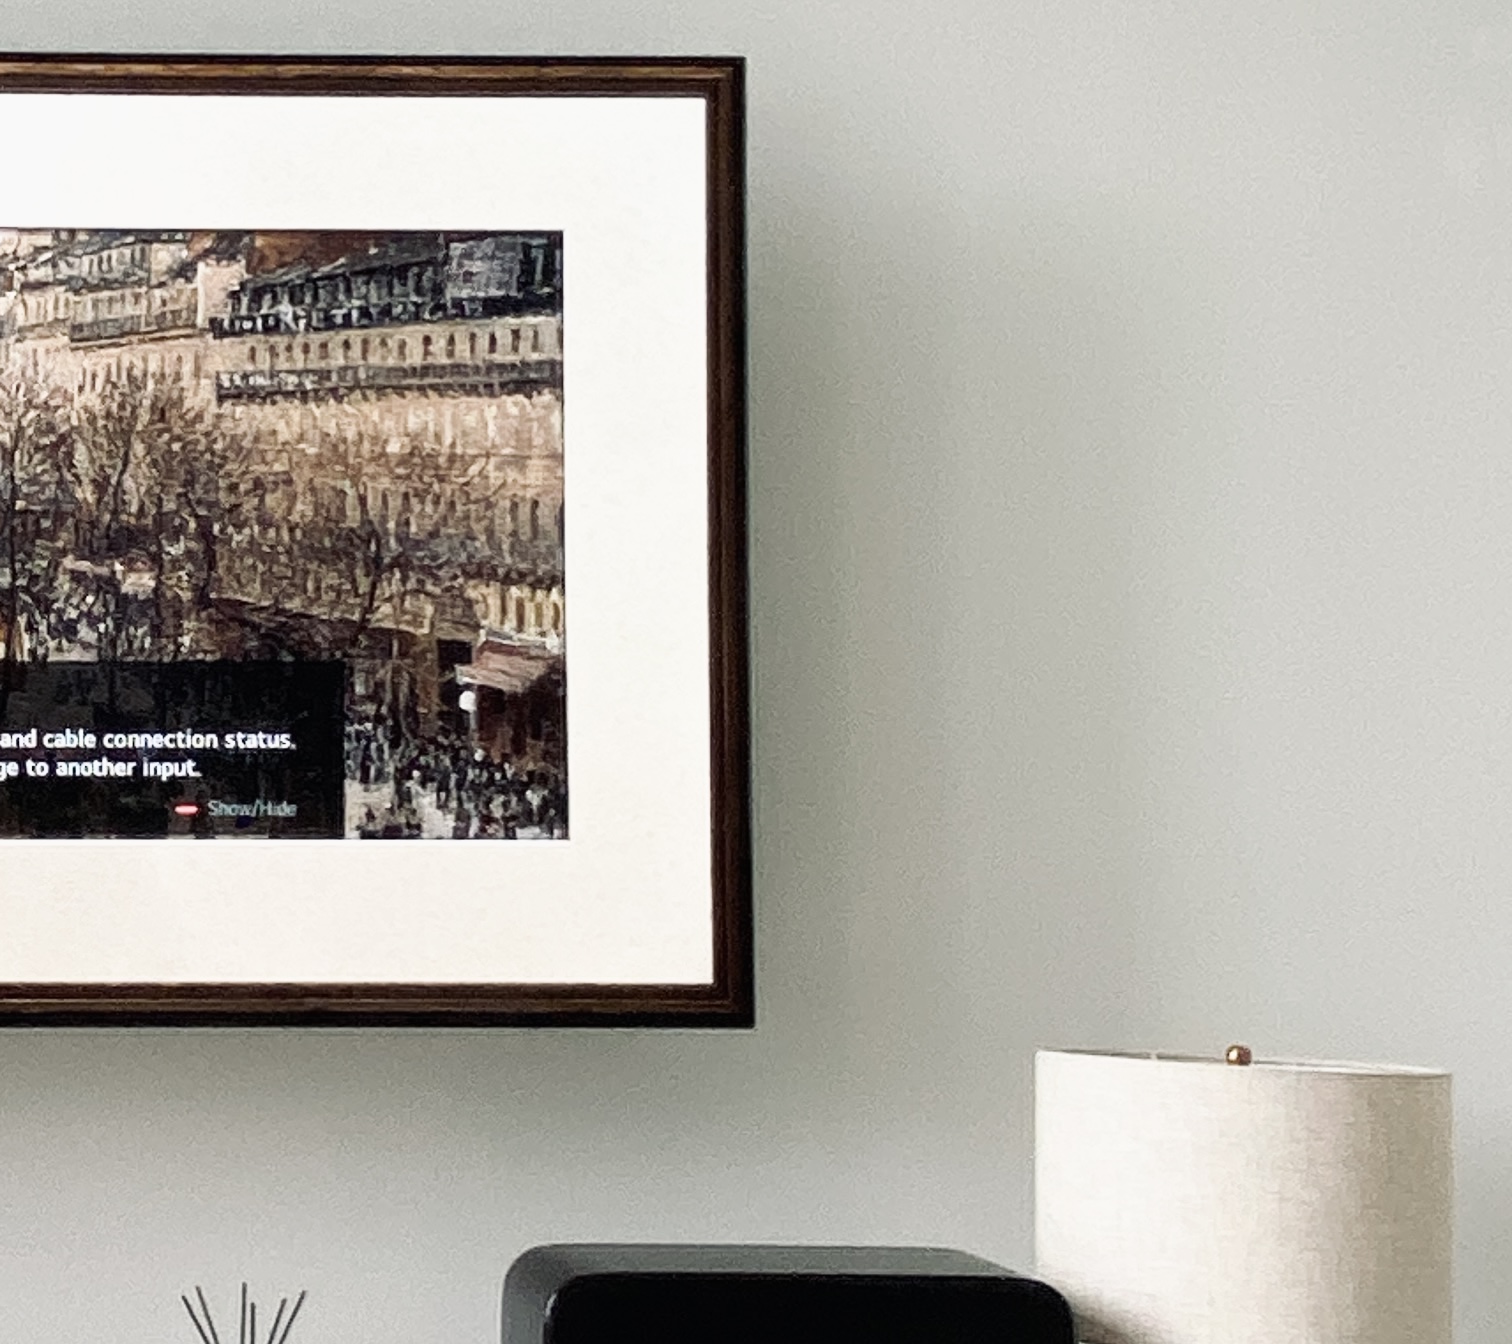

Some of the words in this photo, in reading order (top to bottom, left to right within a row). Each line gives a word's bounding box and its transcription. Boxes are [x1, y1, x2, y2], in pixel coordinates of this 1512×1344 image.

[0, 727, 38, 749] and
[42, 727, 97, 749] cable
[102, 727, 220, 749] connection
[223, 730, 297, 750] status.
[25, 757, 50, 777] to
[55, 755, 138, 777] another
[142, 756, 203, 782] input.
[206, 798, 298, 818] Show/Hide
